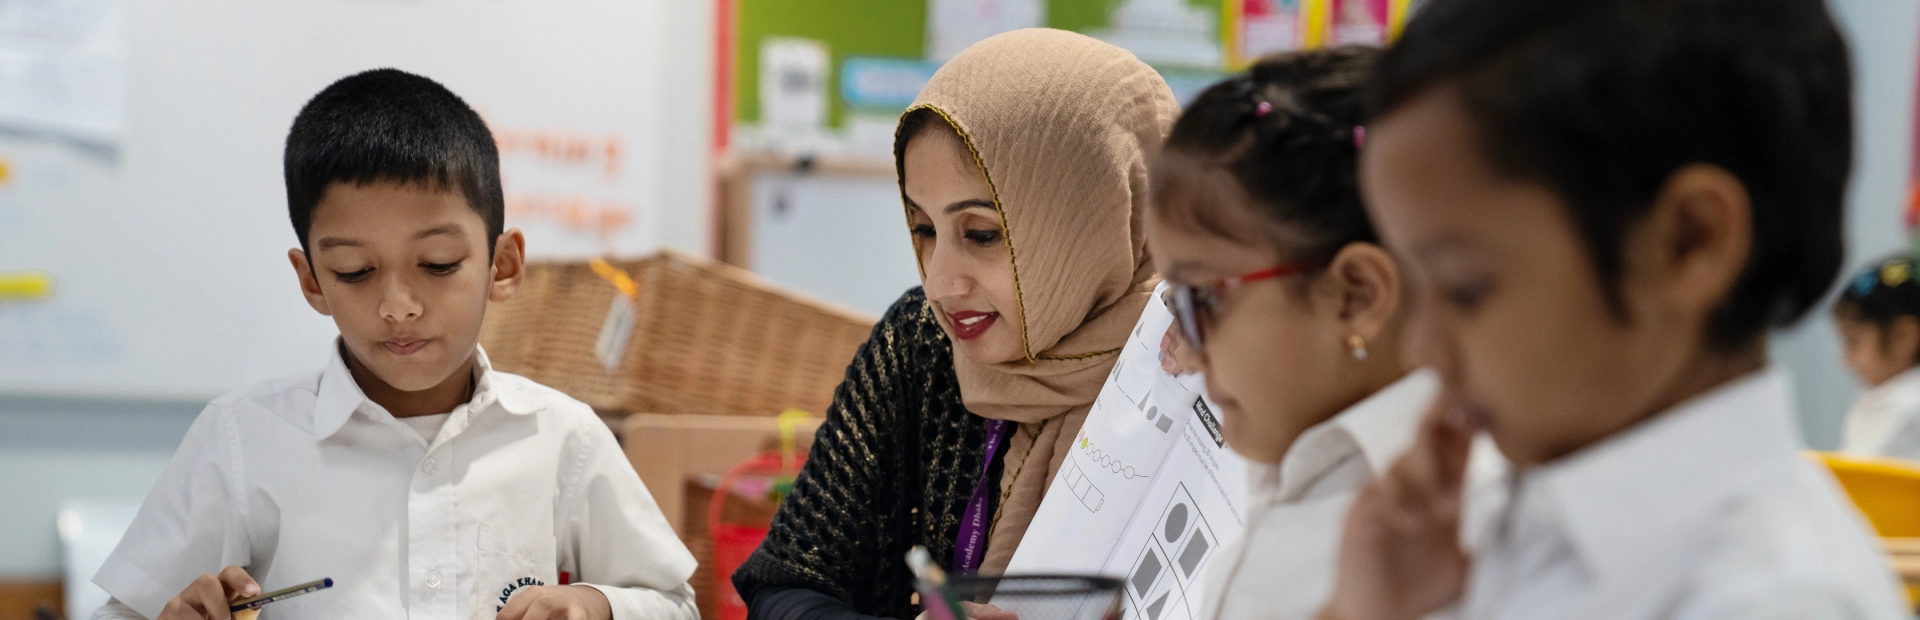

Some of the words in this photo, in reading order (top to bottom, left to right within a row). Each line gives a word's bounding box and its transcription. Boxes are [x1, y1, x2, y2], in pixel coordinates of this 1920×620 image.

[1195, 401, 1205, 418] Mind
[1203, 413, 1224, 443] Challenge
[962, 528, 981, 572] Academy
[972, 497, 983, 528] Dhaka
[499, 583, 517, 604] AGA
